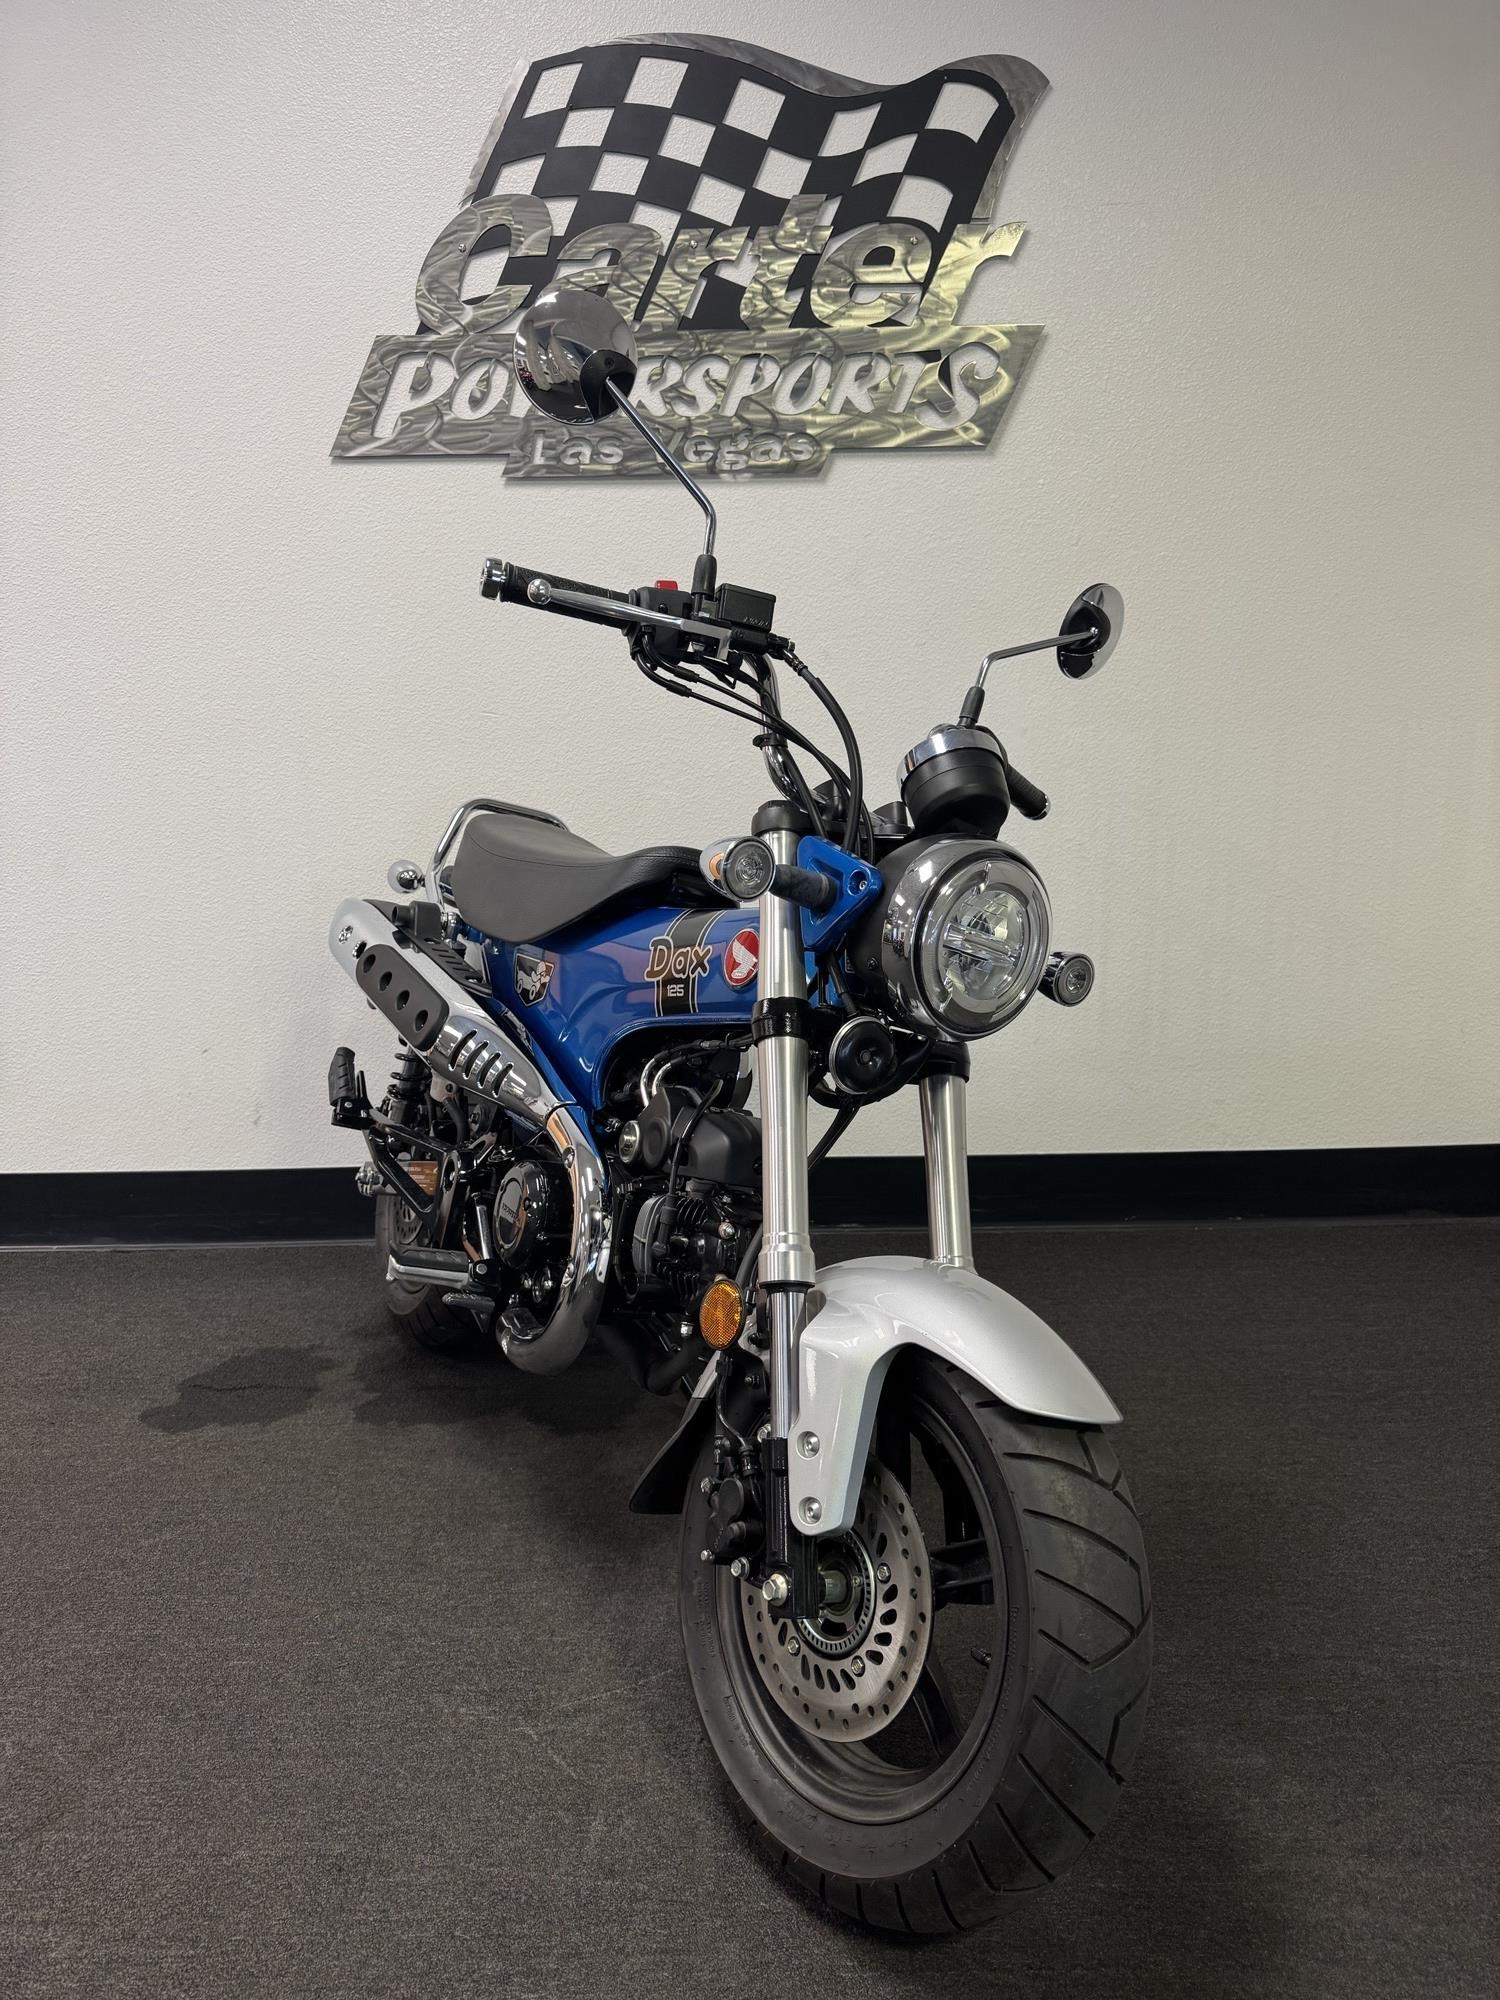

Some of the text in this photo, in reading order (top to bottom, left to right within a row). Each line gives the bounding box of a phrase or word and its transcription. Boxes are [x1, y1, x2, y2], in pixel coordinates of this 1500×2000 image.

[416, 193, 1026, 335] Carter
[373, 342, 1000, 438] PORSPORTS
[533, 430, 624, 465] Las
[644, 936, 713, 981] Dax
[667, 984, 685, 997] 125
